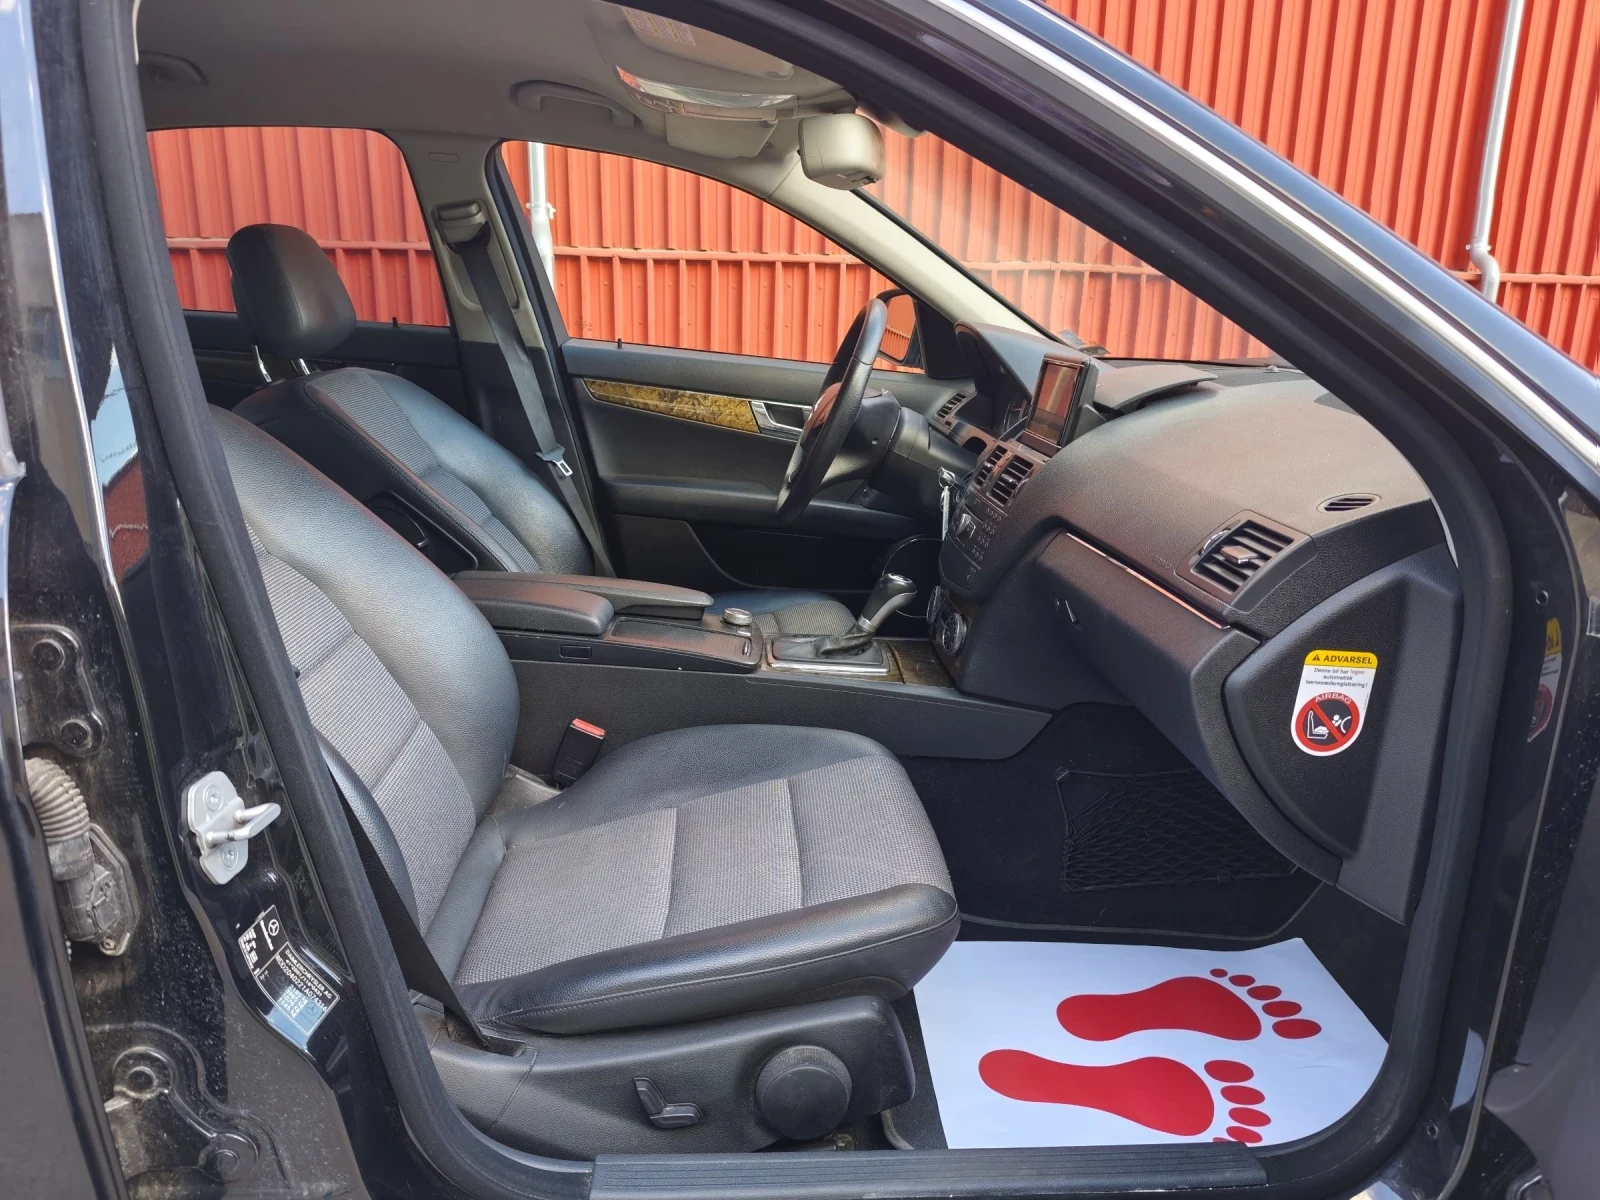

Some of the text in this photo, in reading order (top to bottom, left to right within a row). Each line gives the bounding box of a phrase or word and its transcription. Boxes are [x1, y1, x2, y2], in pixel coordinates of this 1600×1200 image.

[1323, 655, 1372, 664] ADVARSEL
[1315, 693, 1352, 704] AIRBAG
[324, 990, 333, 1000] AG
